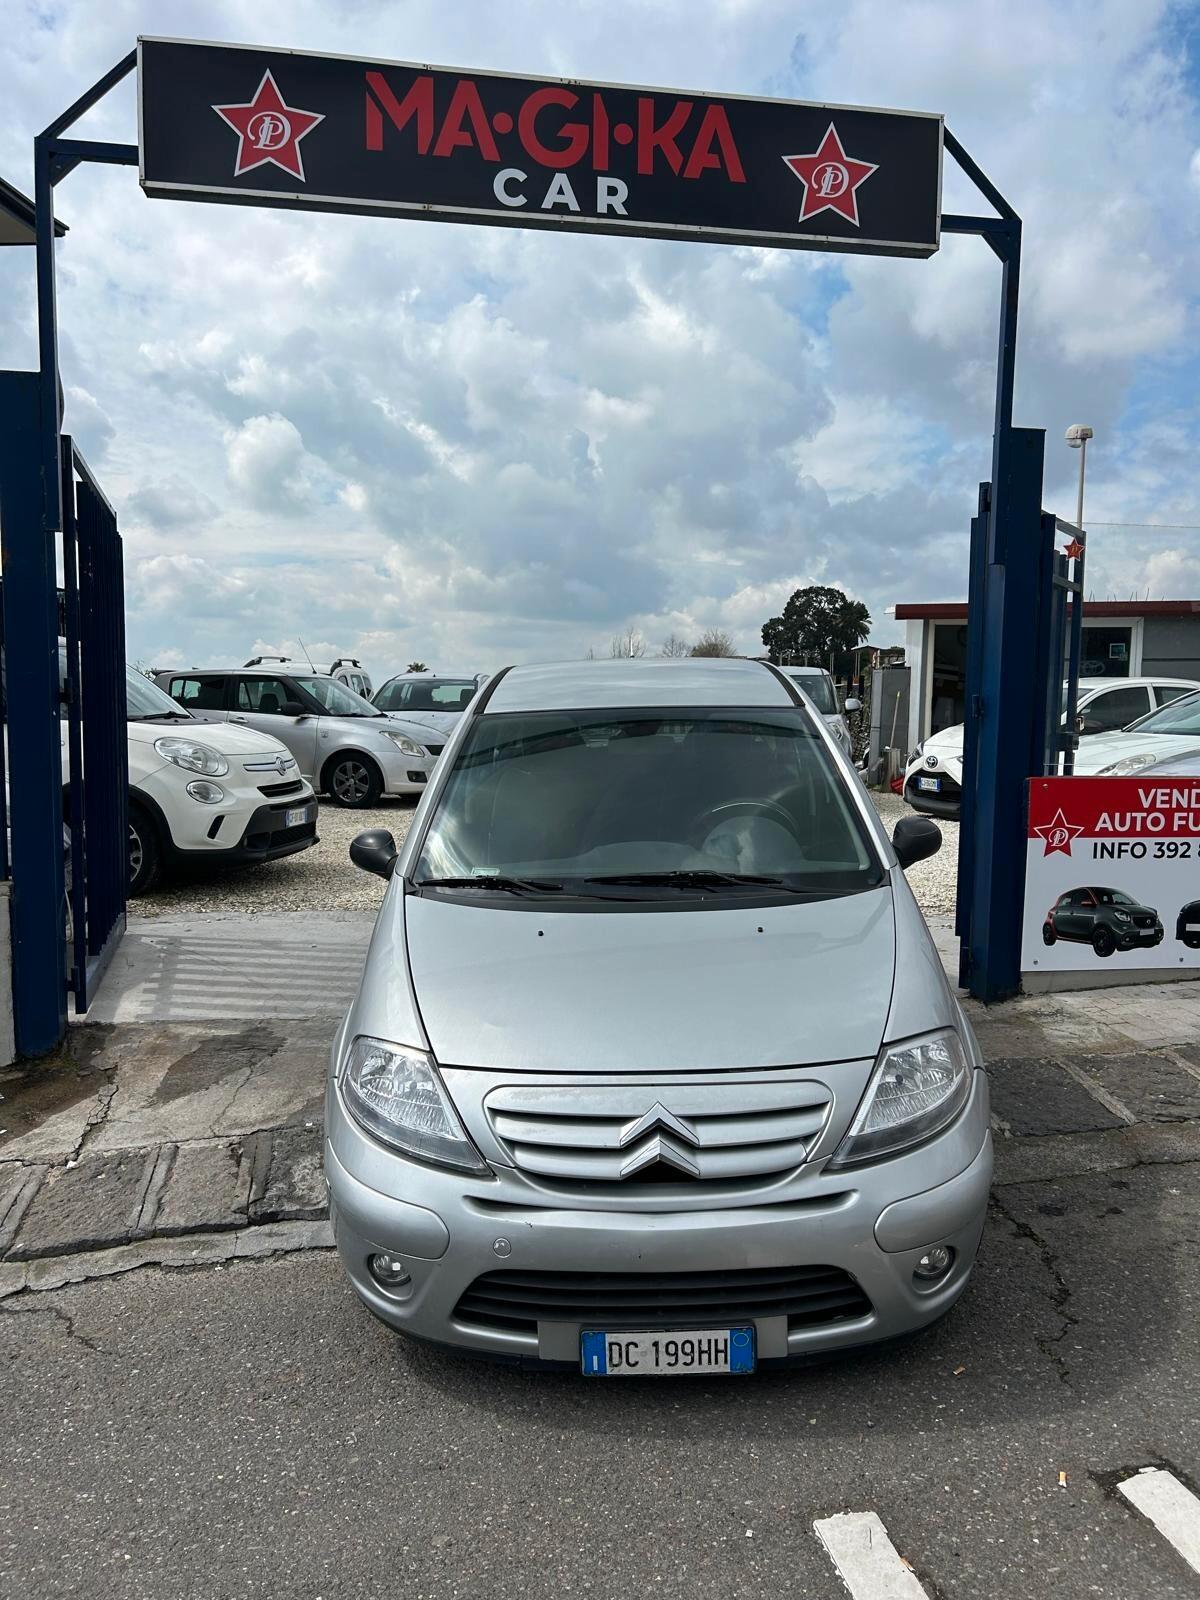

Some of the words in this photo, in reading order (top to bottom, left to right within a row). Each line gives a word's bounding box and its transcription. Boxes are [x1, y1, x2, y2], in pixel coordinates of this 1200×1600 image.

[493, 168, 629, 216] CAR
[1094, 812, 1166, 832] AUTO
[1173, 812, 1200, 832] FU
[1093, 842, 1147, 859] INFO
[1153, 841, 1191, 859] 392
[608, 1341, 639, 1367] DC
[651, 1338, 728, 1367] 199HH
